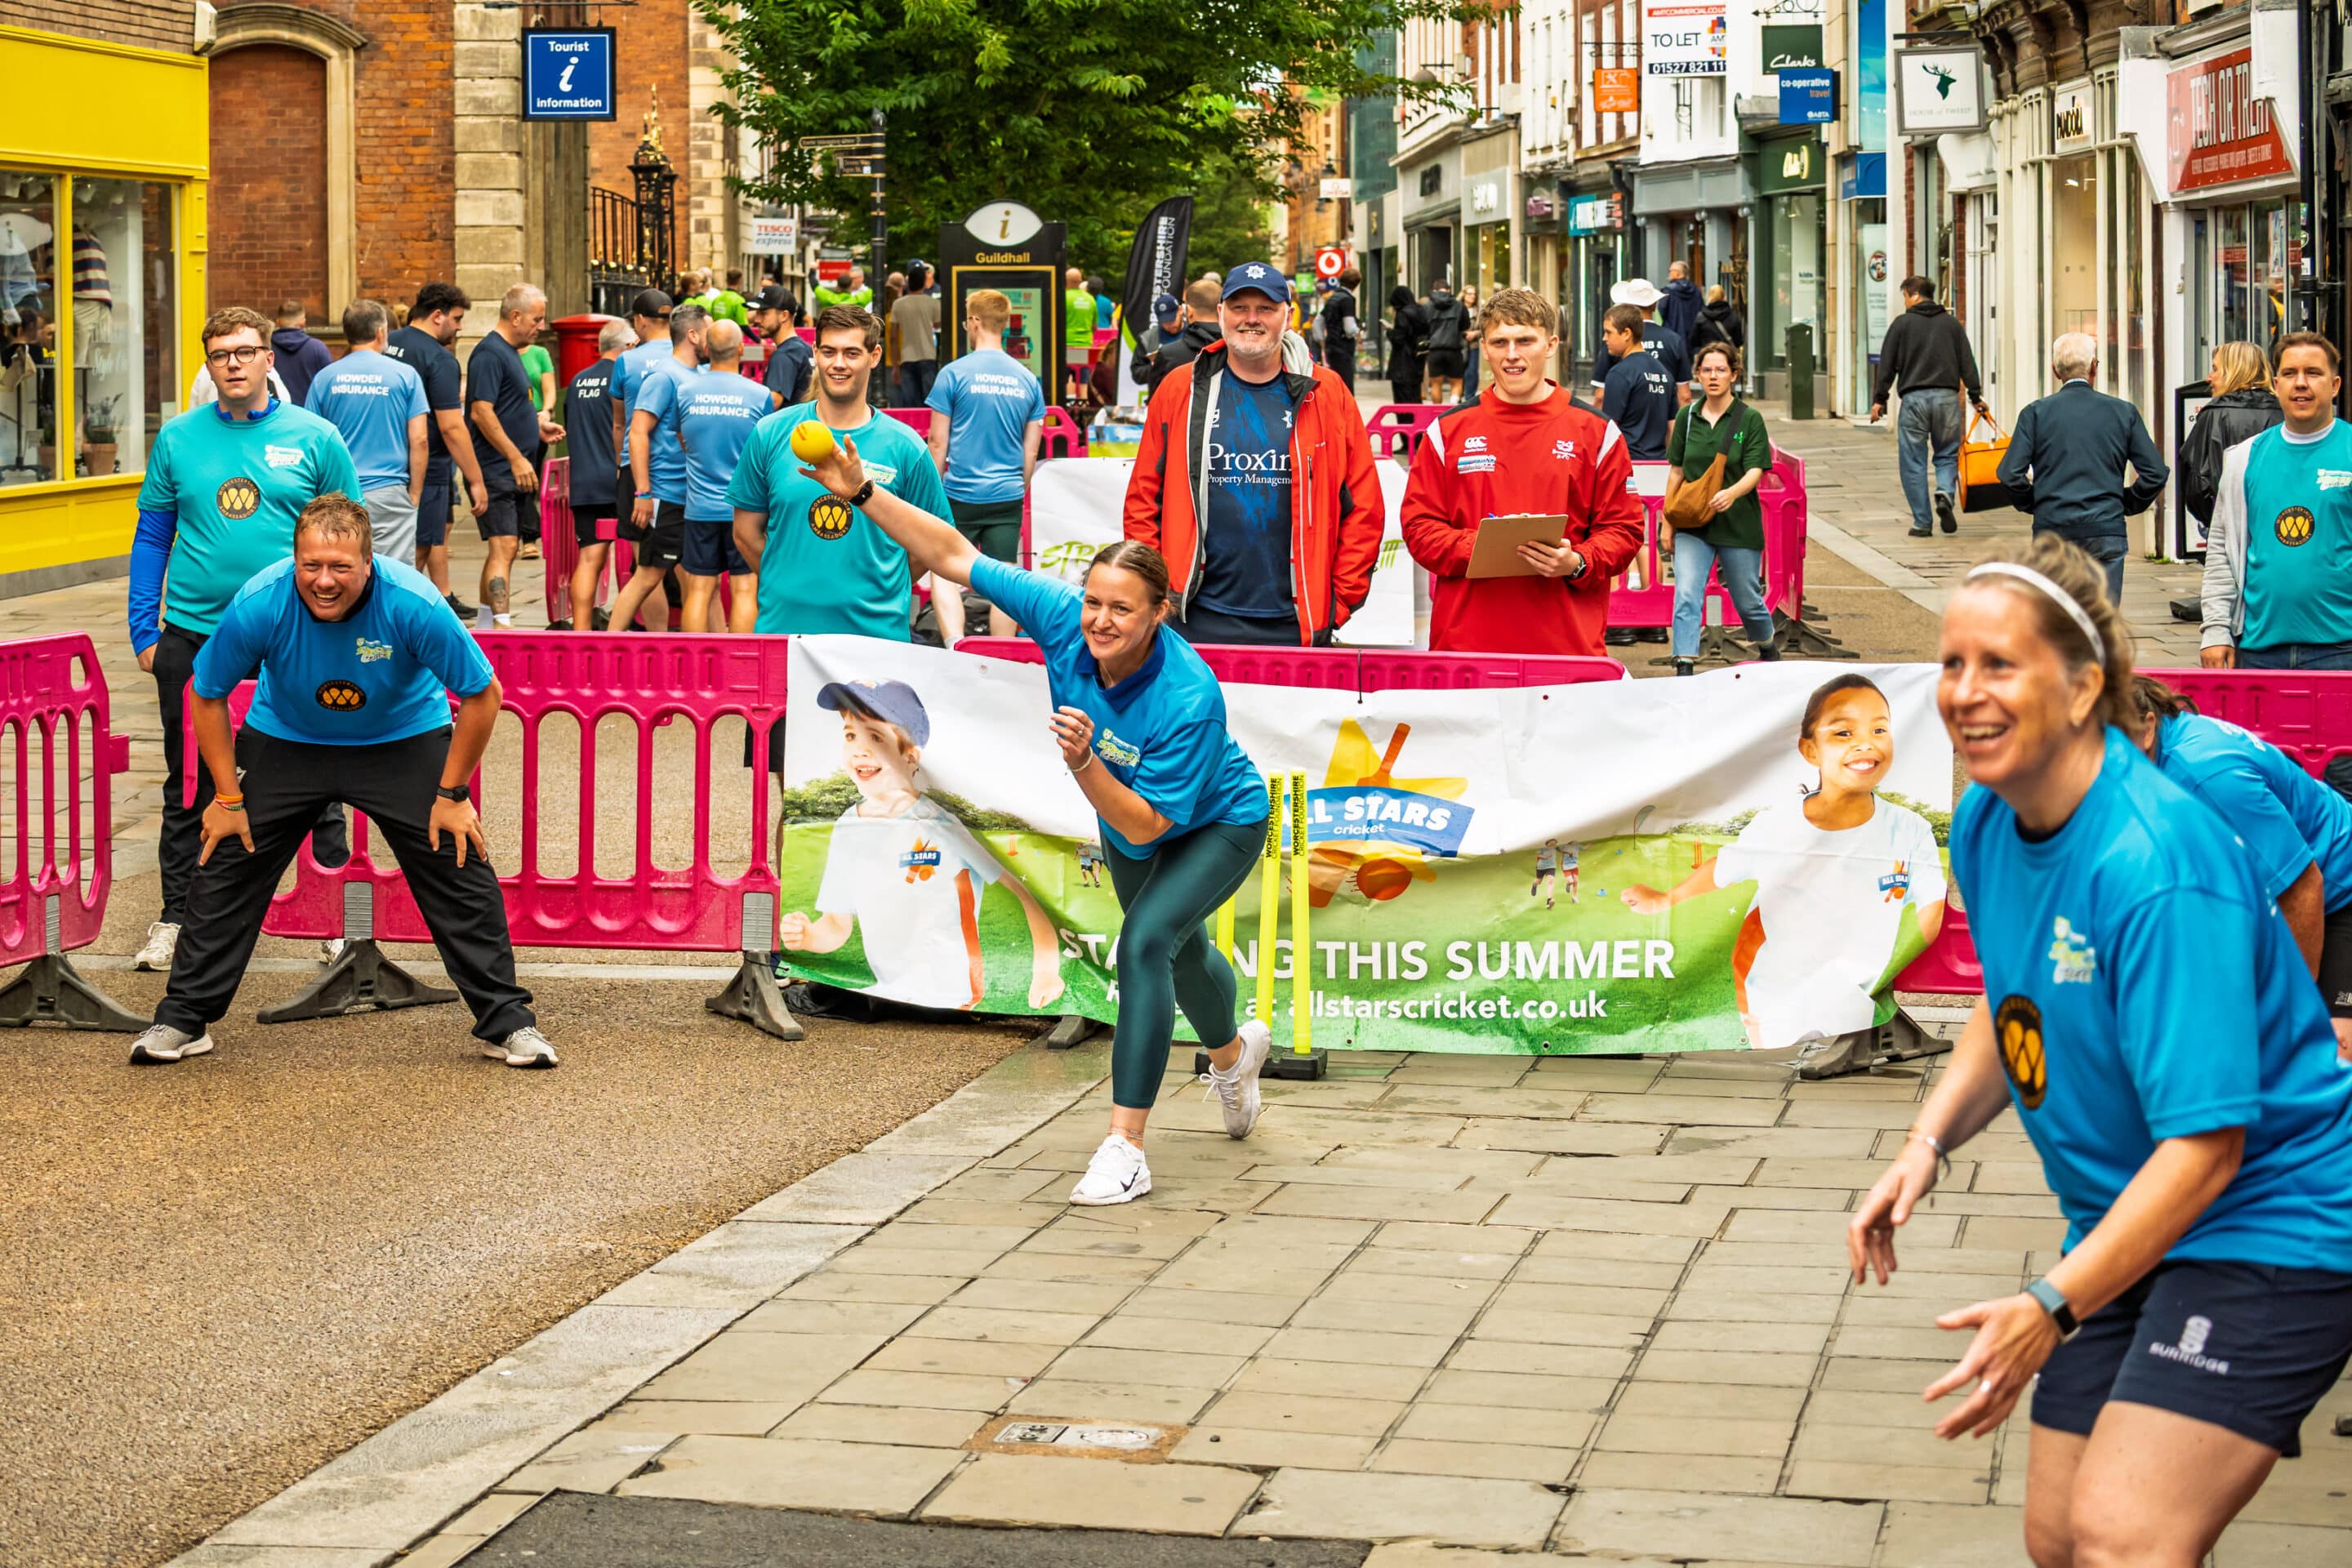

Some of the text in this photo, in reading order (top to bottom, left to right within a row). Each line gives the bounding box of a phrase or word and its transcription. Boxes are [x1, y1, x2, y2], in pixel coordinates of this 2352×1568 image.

[1651, 33, 1701, 47] TO LET
[548, 41, 590, 52] Tourist
[1770, 54, 1816, 68] Clarks
[1653, 64, 1686, 74] 01527
[1689, 61, 1708, 73] 821
[1780, 78, 1830, 89] co-operative
[1809, 88, 1830, 98] travel
[2190, 73, 2216, 150] TECH
[2218, 65, 2234, 144] OR
[2056, 107, 2083, 140] PANDORA
[757, 224, 792, 233] TESCO
[755, 237, 792, 247] express
[975, 252, 1030, 264] Guildhall
[1641, 340, 1664, 350] MB &
[336, 373, 382, 384] HOWDEN
[576, 376, 608, 388] LAMB &
[974, 372, 1018, 385] HOWDEN
[1661, 374, 1668, 383] &
[332, 385, 389, 397] INSURANCE
[578, 389, 600, 399] FLAG
[970, 384, 1026, 399] INSURANCE
[695, 393, 743, 406] HOWDEN
[689, 406, 750, 418] INSURANCE
[1208, 474, 1243, 486] Property
[1266, 777, 1277, 858] WORCESTERSHIRE
[1343, 796, 1451, 831] STARS
[1333, 823, 1386, 835] cricket
[914, 852, 938, 861] STARS
[1315, 940, 1428, 980] THIS
[1446, 939, 1676, 980] SUMMER
